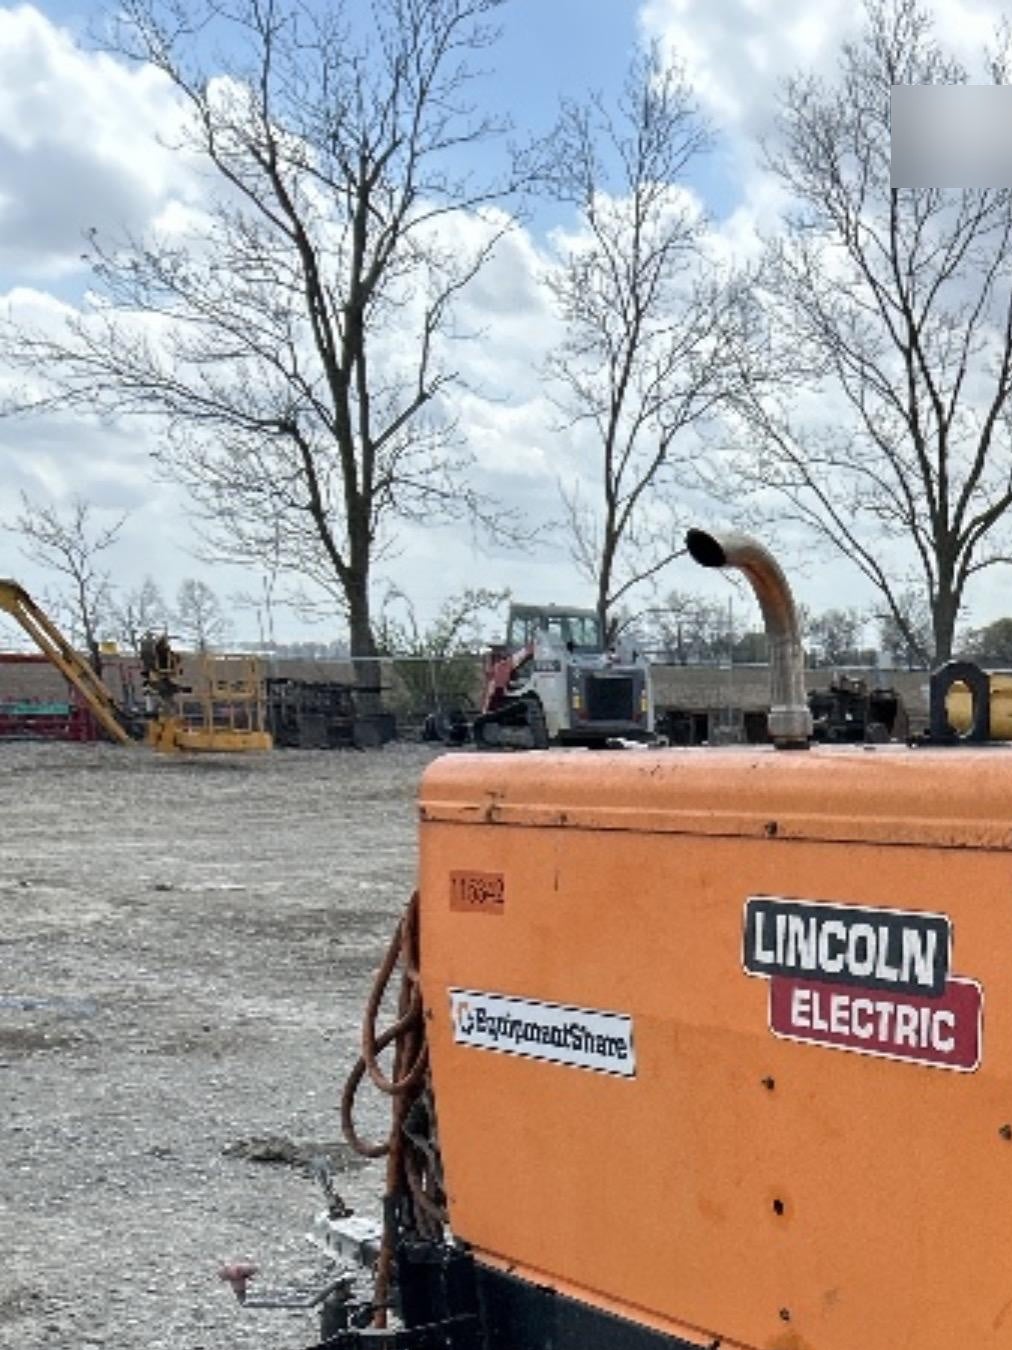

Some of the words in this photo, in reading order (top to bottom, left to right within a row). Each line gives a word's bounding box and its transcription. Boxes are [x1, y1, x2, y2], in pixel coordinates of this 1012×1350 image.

[754, 911, 937, 988] LINCOLN
[475, 1006, 628, 1060] EquipmentShare
[790, 988, 956, 1053] ELECTRIC
